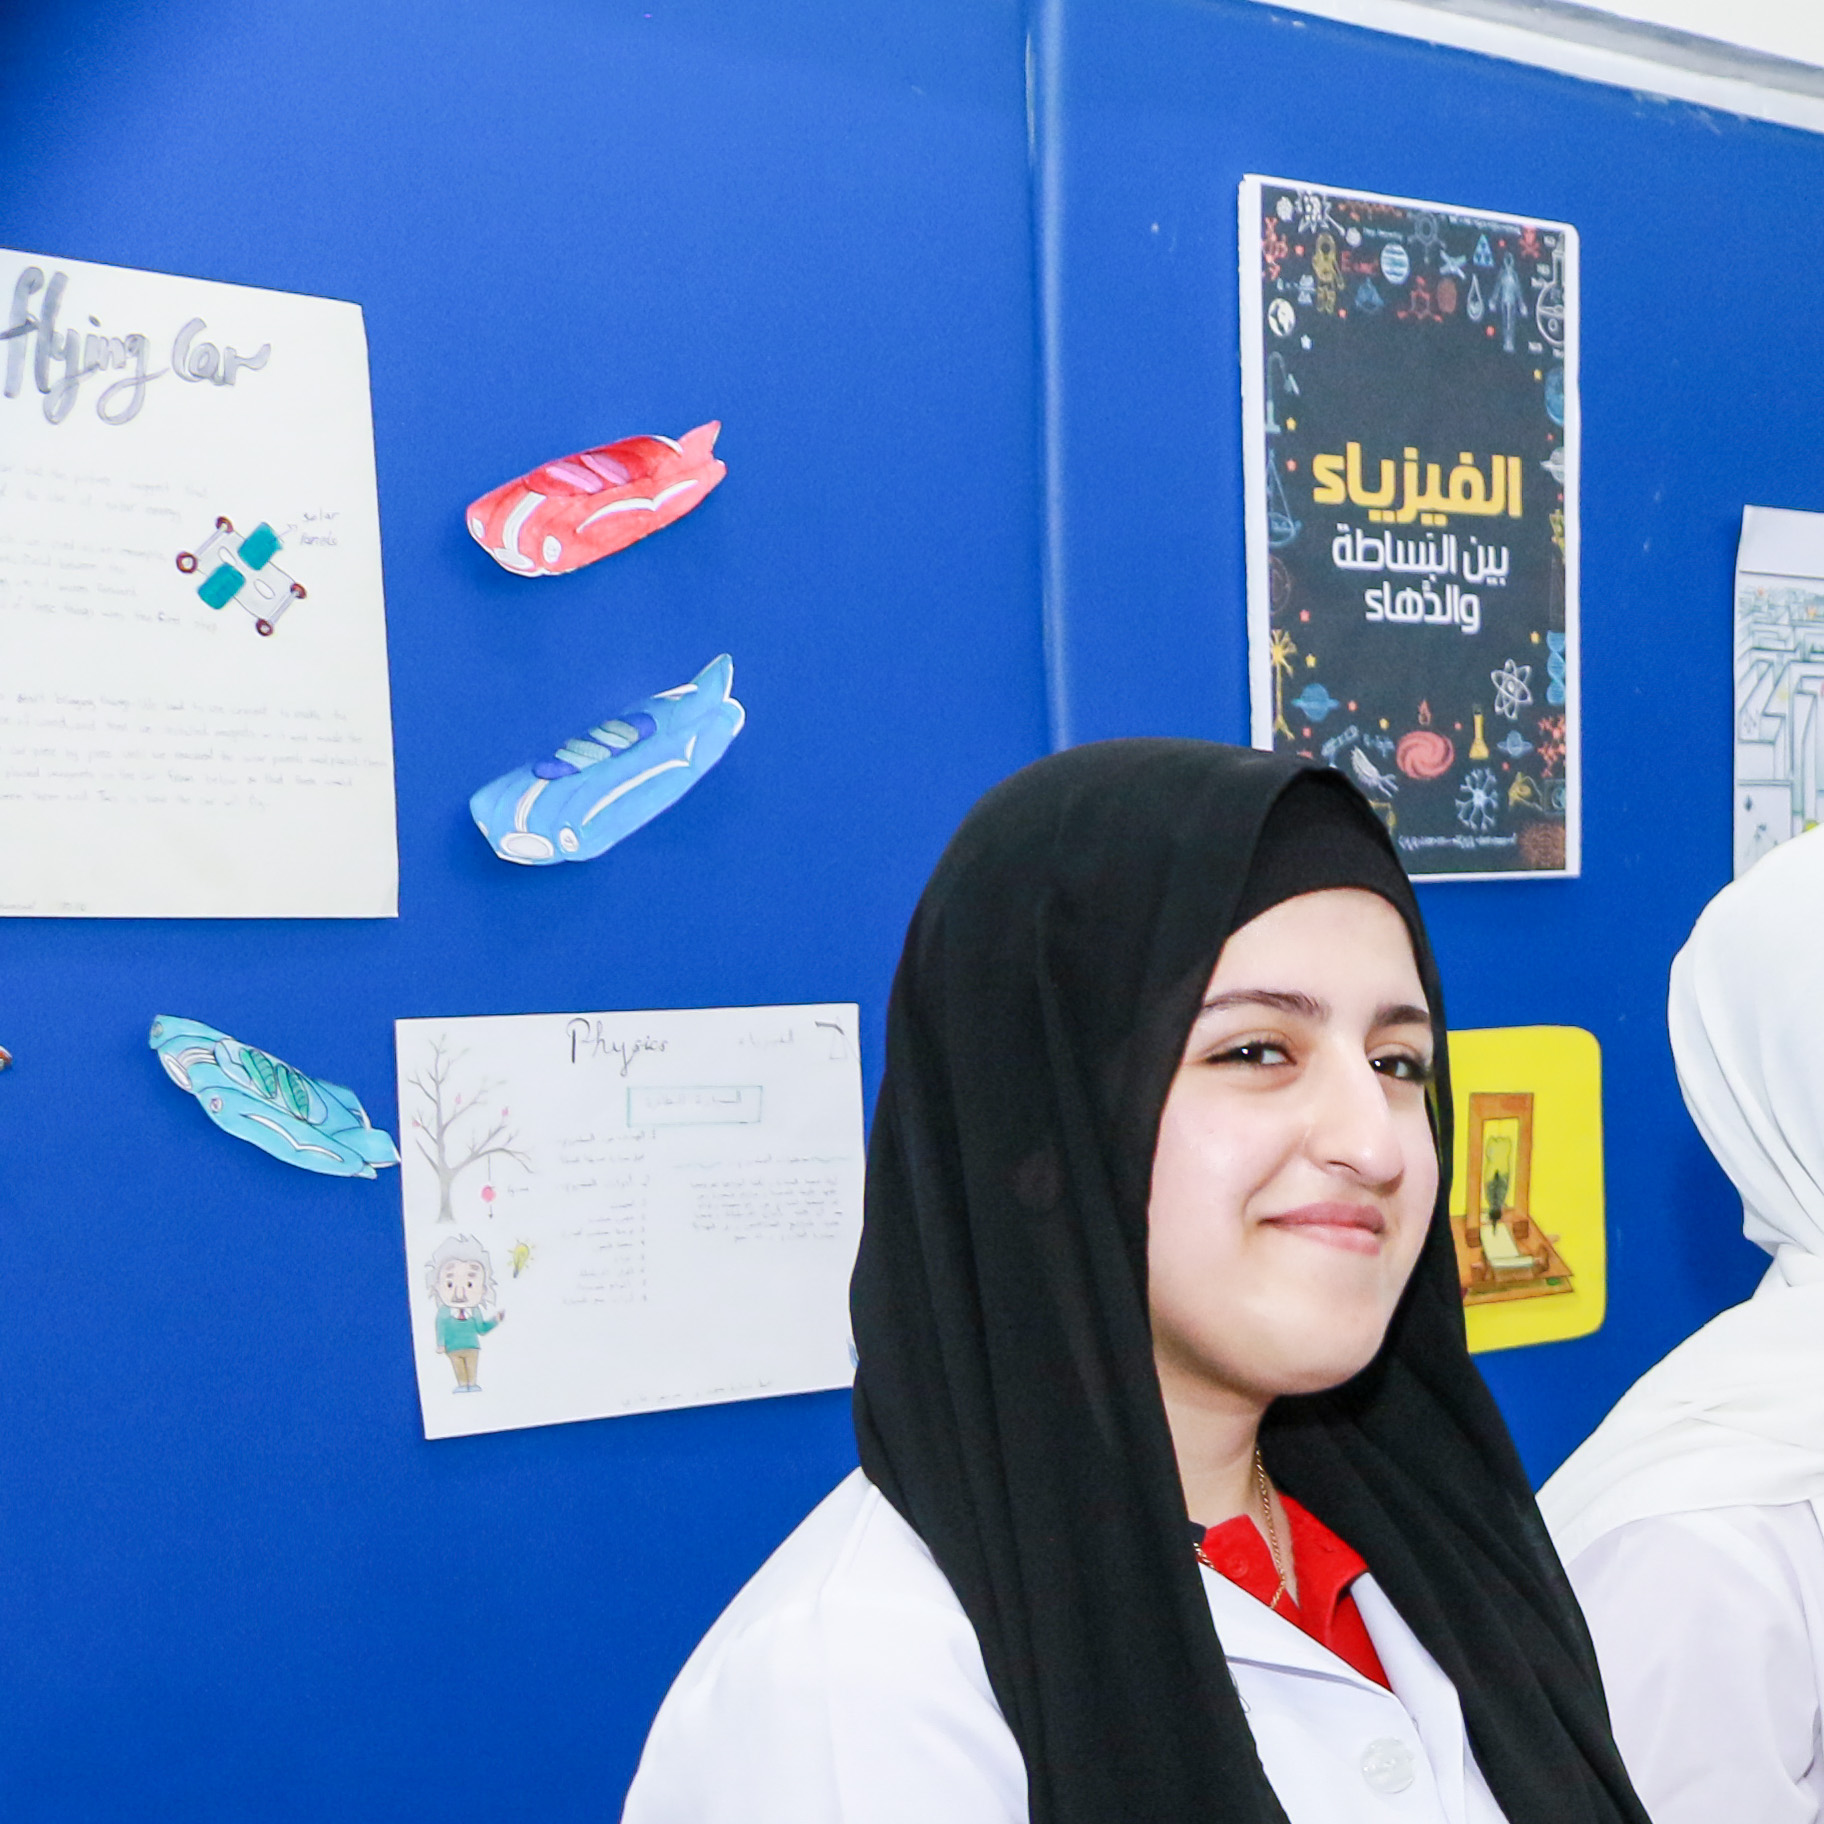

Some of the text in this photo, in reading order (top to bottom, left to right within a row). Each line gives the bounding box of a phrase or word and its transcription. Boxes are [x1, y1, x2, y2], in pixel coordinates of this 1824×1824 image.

[1312, 441, 1522, 526] الفيزياء
[1463, 535, 1509, 586] بين
[566, 1017, 668, 1077] Physics
